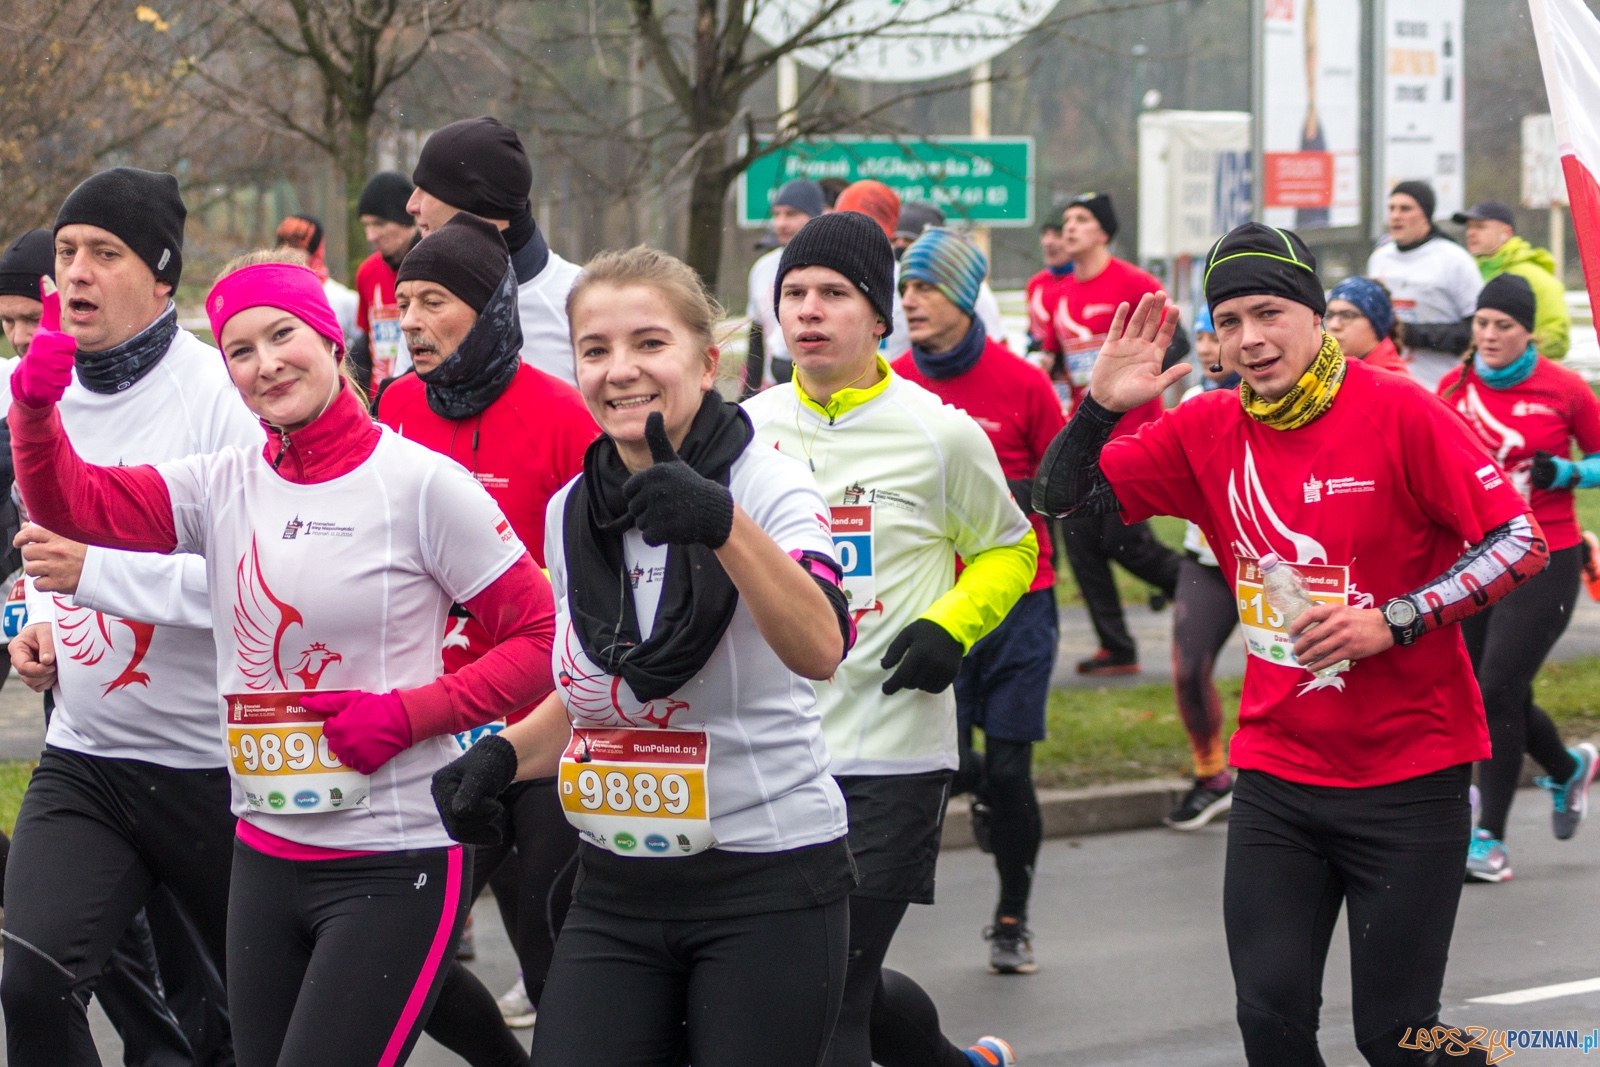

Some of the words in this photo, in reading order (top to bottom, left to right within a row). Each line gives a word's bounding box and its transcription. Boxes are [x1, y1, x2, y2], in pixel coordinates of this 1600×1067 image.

[832, 516, 864, 526] land.org
[1240, 599, 1248, 610] D
[1274, 635, 1292, 644] Dawi
[232, 746, 239, 758] D
[633, 744, 698, 756] RunPoland.org
[563, 781, 573, 794] D
[577, 769, 690, 815] 9889
